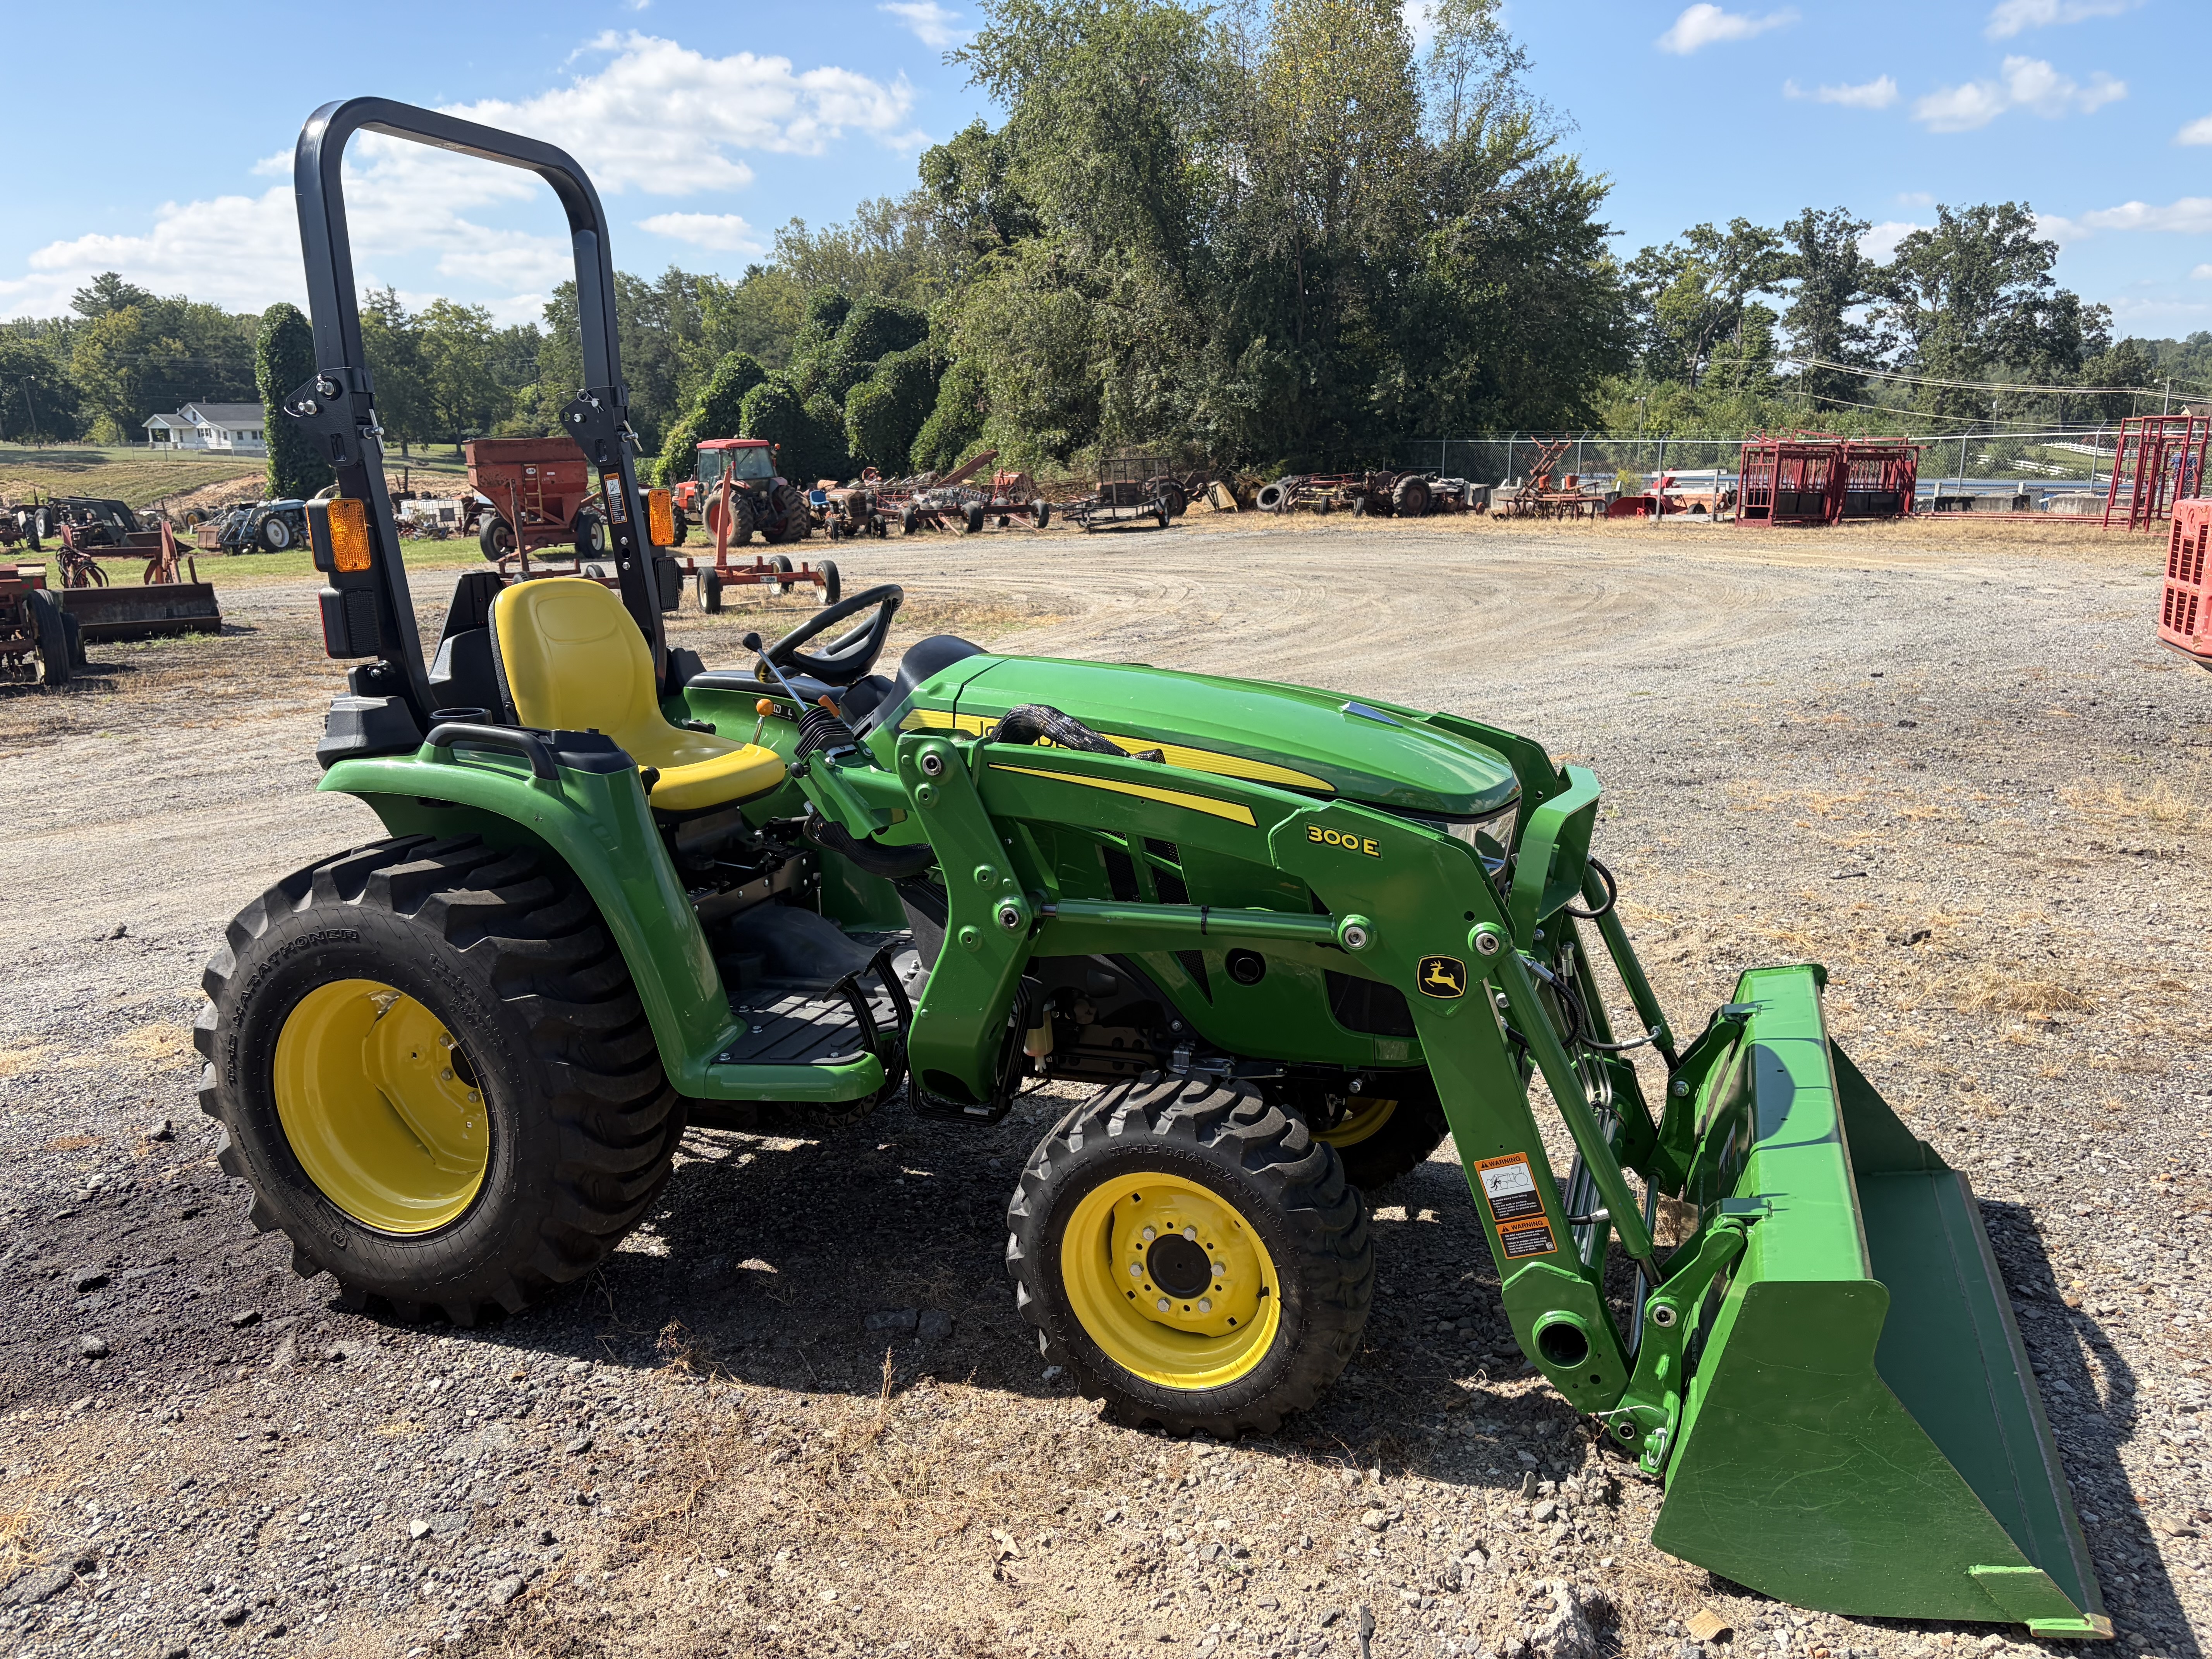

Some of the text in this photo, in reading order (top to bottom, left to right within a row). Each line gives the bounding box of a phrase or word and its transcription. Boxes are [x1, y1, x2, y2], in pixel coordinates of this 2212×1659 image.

[774, 704, 781, 713] N
[227, 928, 359, 1083] THE MARATHONER
[1108, 1144, 1159, 1158] THE
[1488, 1156, 1521, 1167] WARNING
[1511, 1220, 1543, 1230] WARNING
